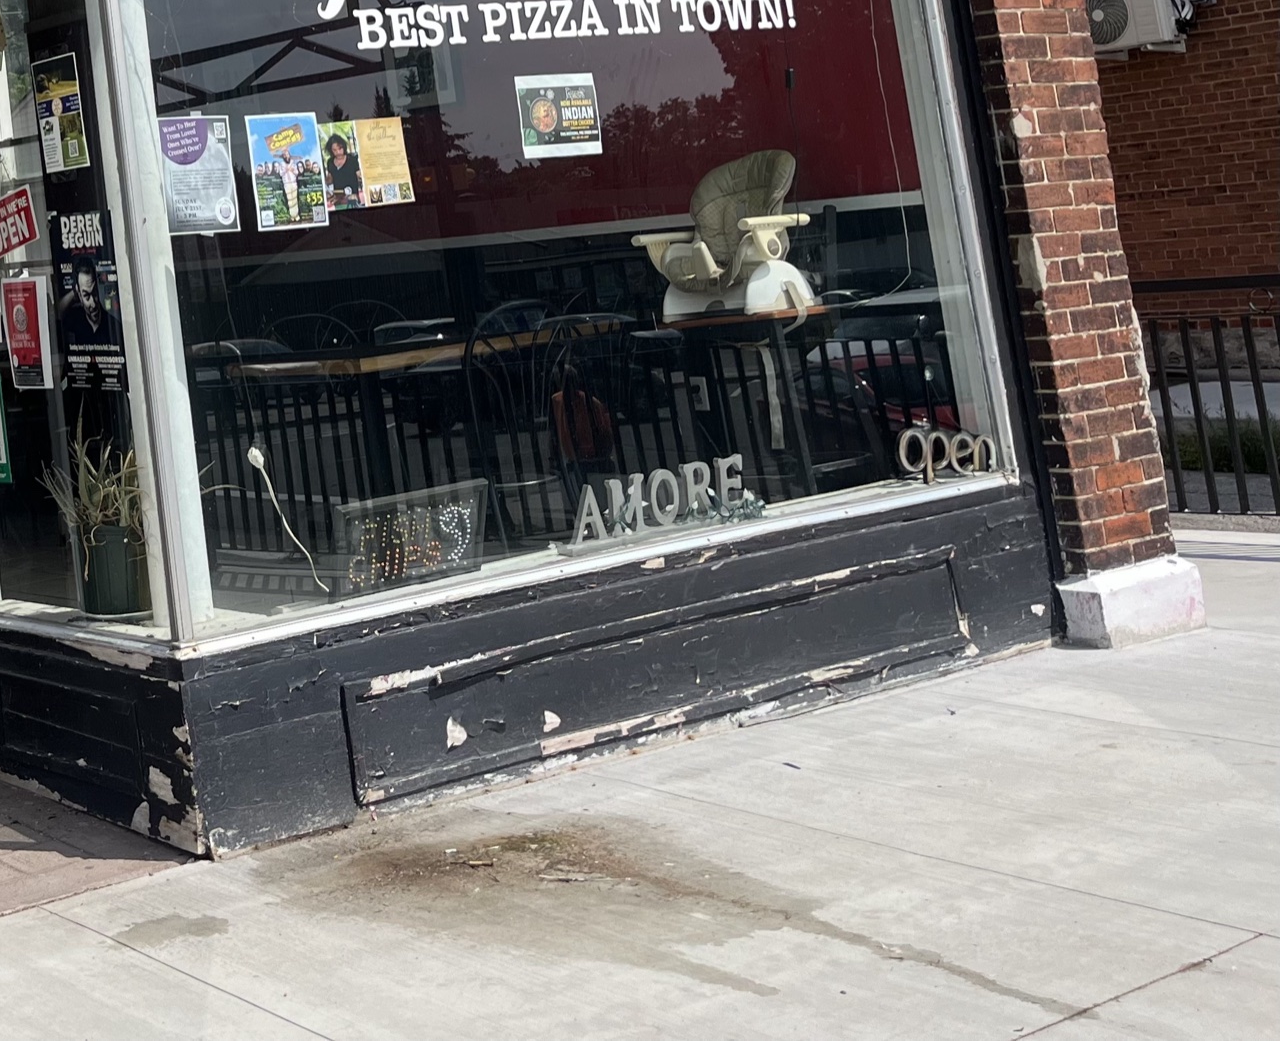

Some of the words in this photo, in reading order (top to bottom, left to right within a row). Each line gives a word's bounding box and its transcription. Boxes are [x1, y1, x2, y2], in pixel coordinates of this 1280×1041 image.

[352, 2, 469, 51] BEST
[561, 105, 595, 121] INDIAN
[180, 127, 197, 138] Loved
[270, 132, 302, 150] Comedy
[273, 129, 294, 142] Camp
[306, 190, 324, 207] $35
[60, 213, 102, 234] DEREK
[61, 230, 104, 250] SEGUIN
[570, 454, 745, 545] AMORE
